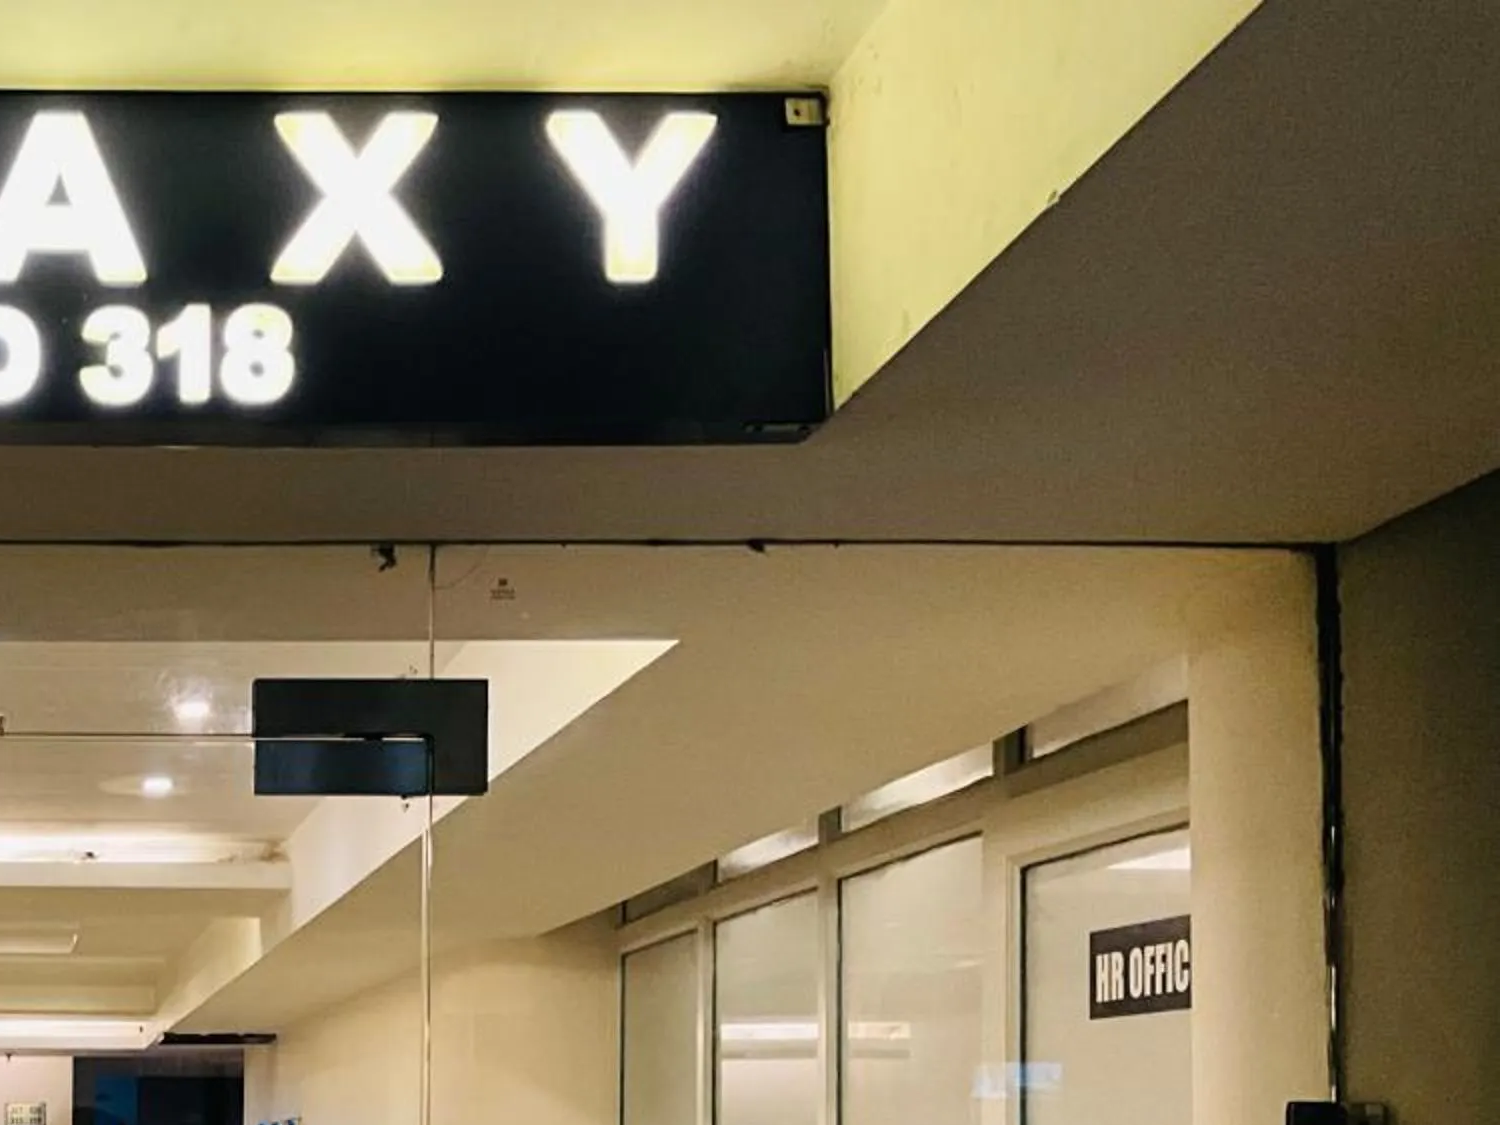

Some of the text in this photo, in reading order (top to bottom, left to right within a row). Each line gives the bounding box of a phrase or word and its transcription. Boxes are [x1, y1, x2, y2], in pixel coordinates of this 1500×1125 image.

[79, 302, 296, 406] 318
[1096, 939, 1190, 1003] HR OFFIC
